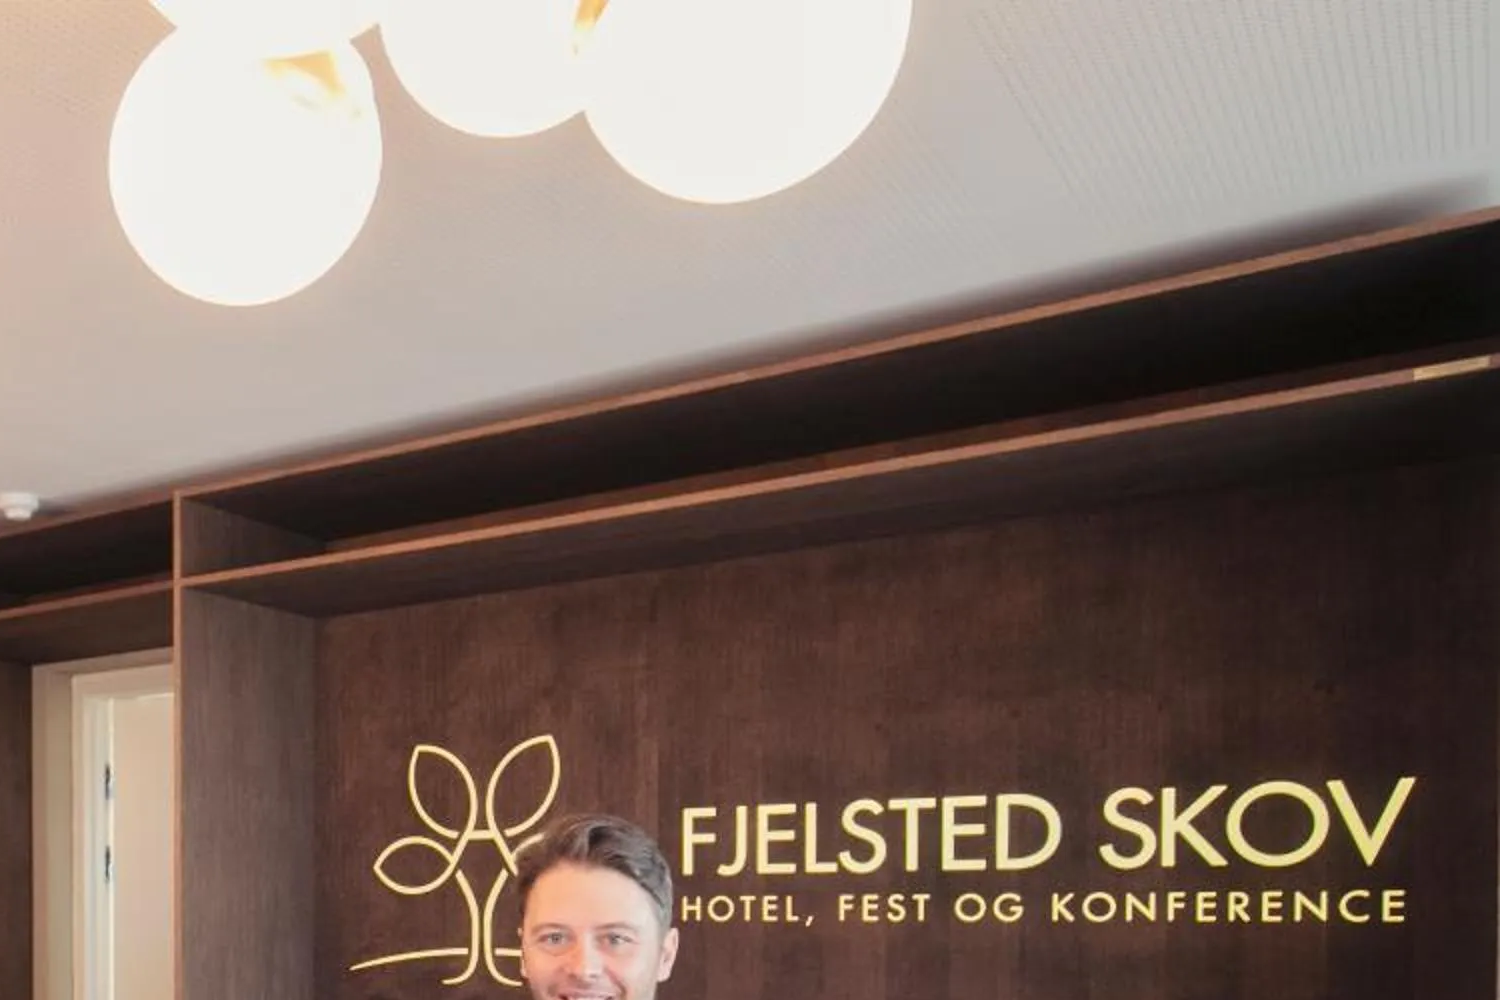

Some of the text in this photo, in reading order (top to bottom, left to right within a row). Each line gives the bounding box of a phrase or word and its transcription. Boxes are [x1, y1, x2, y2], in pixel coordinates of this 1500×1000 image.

[681, 776, 1416, 877] FJELSTED SKOV
[681, 888, 1406, 928] HOTEL, FEST OG KONFERENCE
